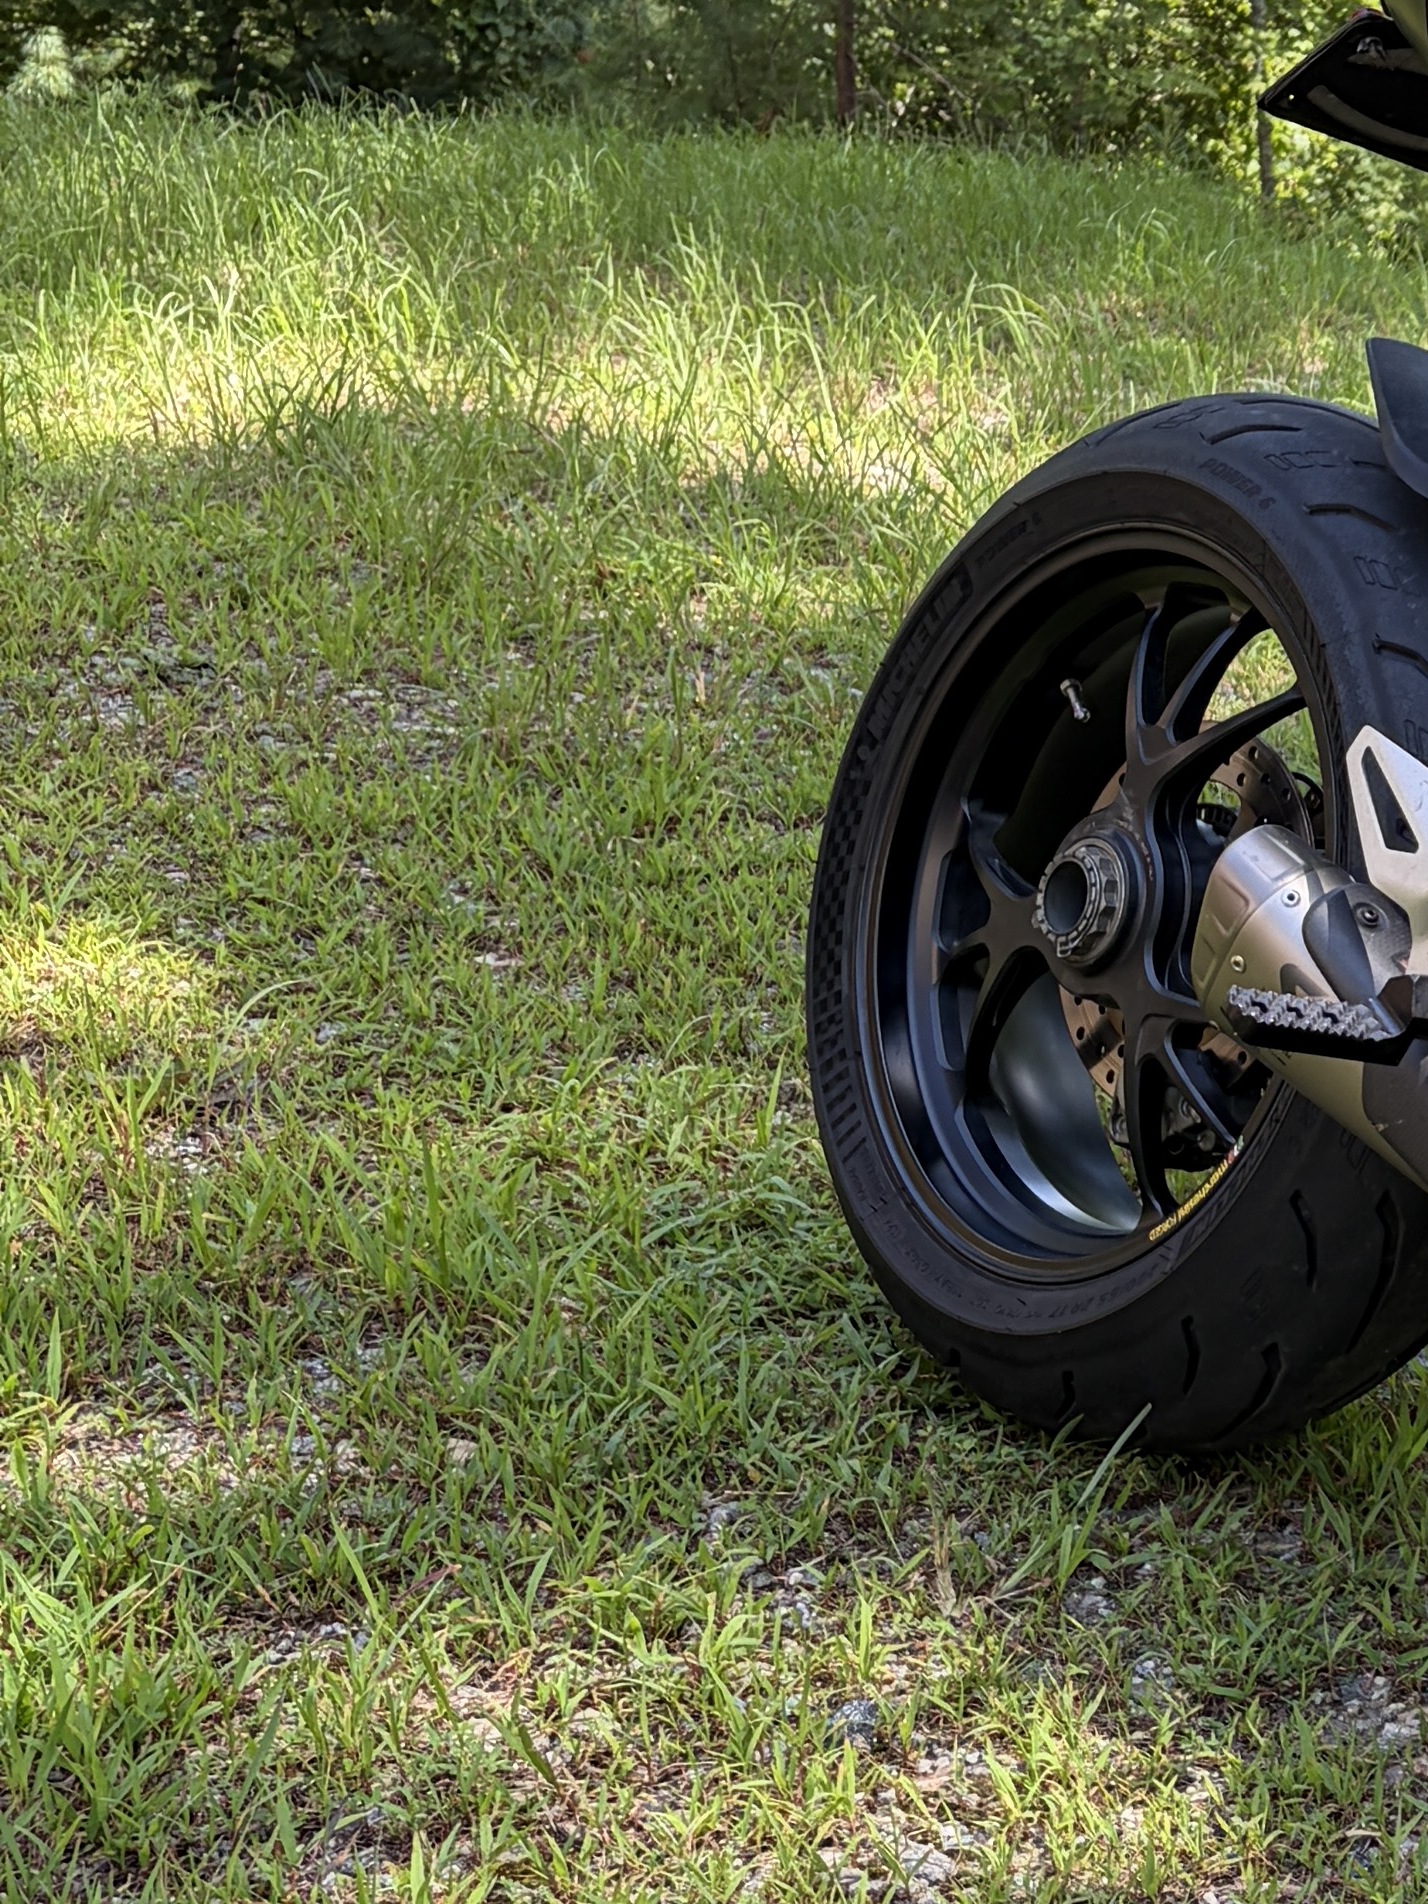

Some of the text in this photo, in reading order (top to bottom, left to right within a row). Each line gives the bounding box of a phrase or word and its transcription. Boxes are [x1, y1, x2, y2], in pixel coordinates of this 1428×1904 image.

[1198, 457, 1277, 510] POWER 6
[867, 576, 964, 742] MICHELIN
